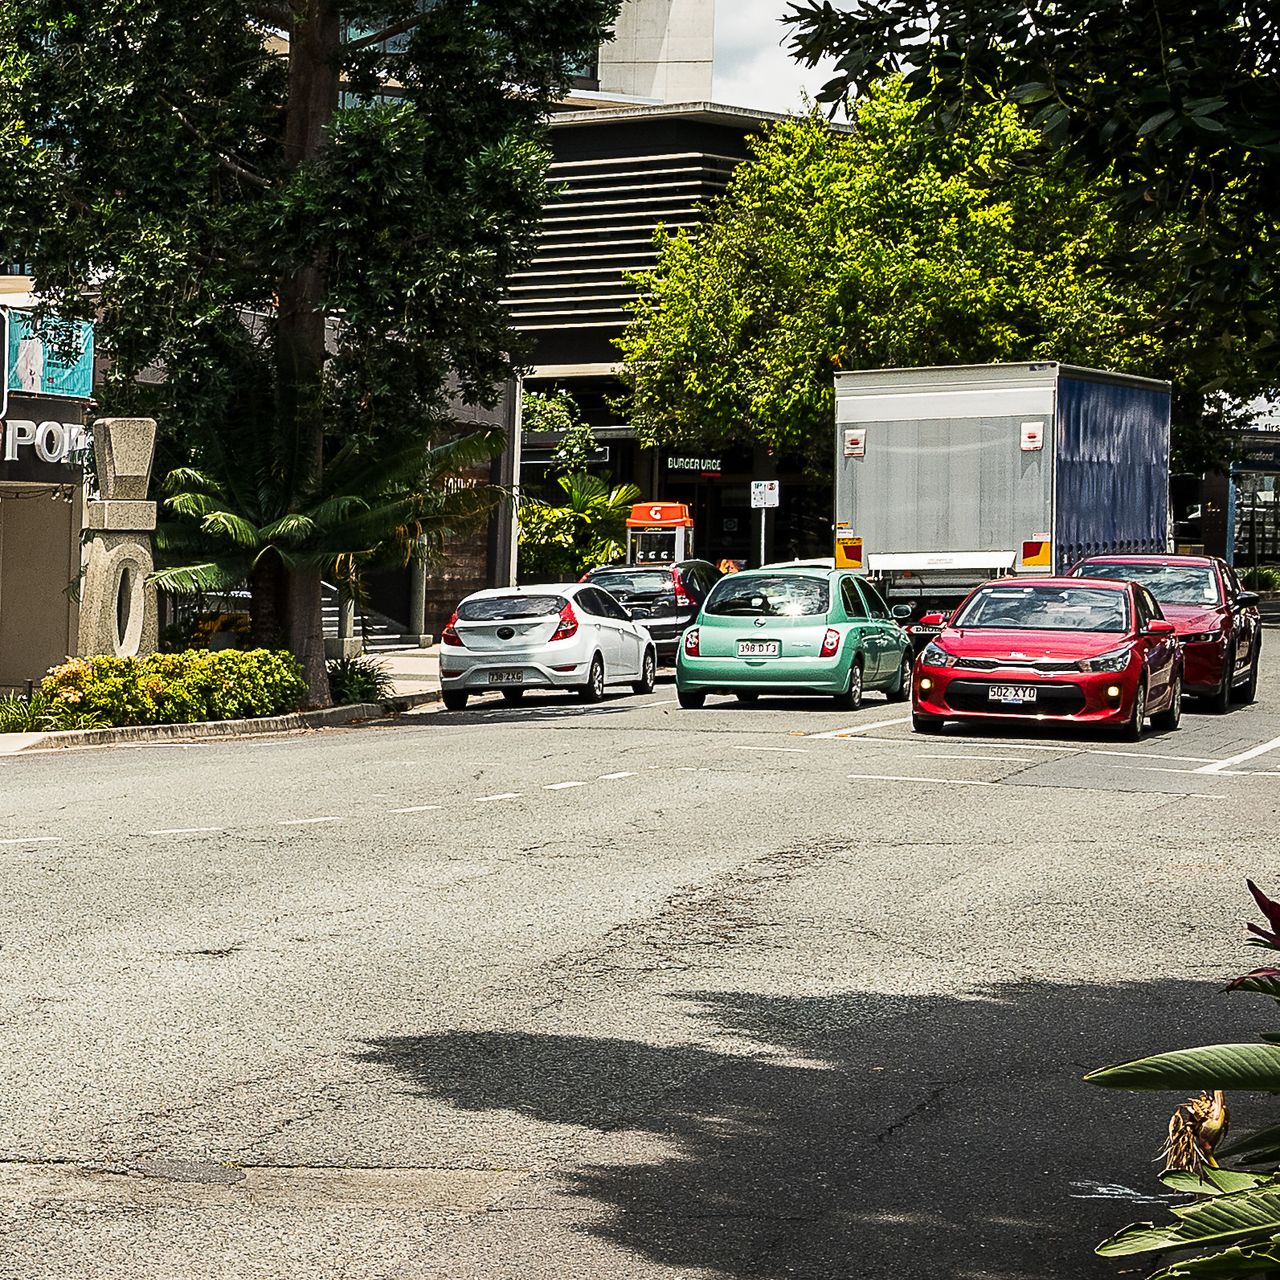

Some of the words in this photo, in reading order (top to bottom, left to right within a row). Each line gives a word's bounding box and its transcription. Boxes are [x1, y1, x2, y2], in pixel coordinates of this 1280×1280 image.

[668, 457, 700, 469] BURGER
[701, 459, 721, 470] URGE
[990, 687, 1009, 697] 502
